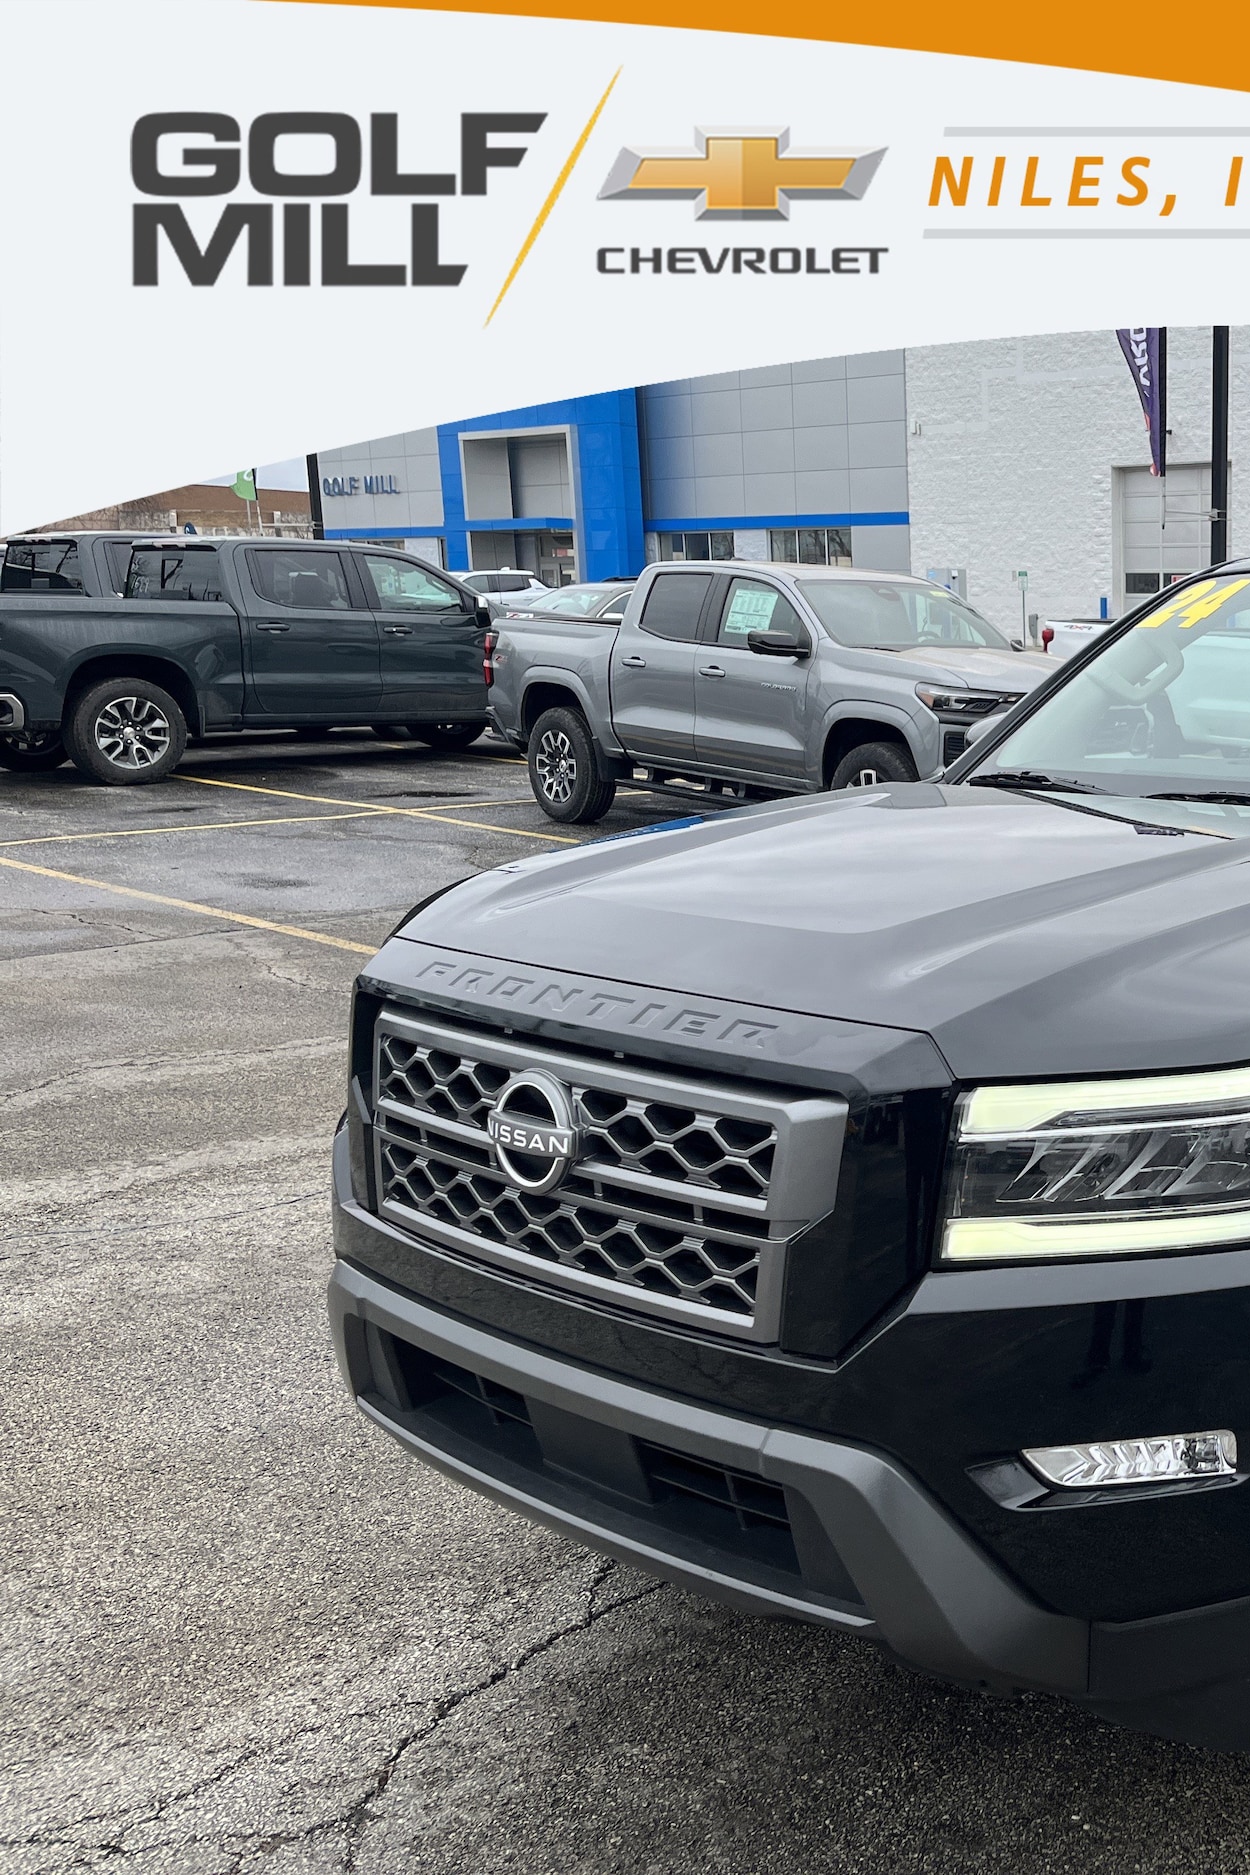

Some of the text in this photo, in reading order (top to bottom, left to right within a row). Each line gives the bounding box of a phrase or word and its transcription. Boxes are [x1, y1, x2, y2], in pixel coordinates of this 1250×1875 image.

[364, 474, 400, 494] MILL
[415, 961, 780, 1048] FRONTIER
[488, 1117, 568, 1154] NISSAN
